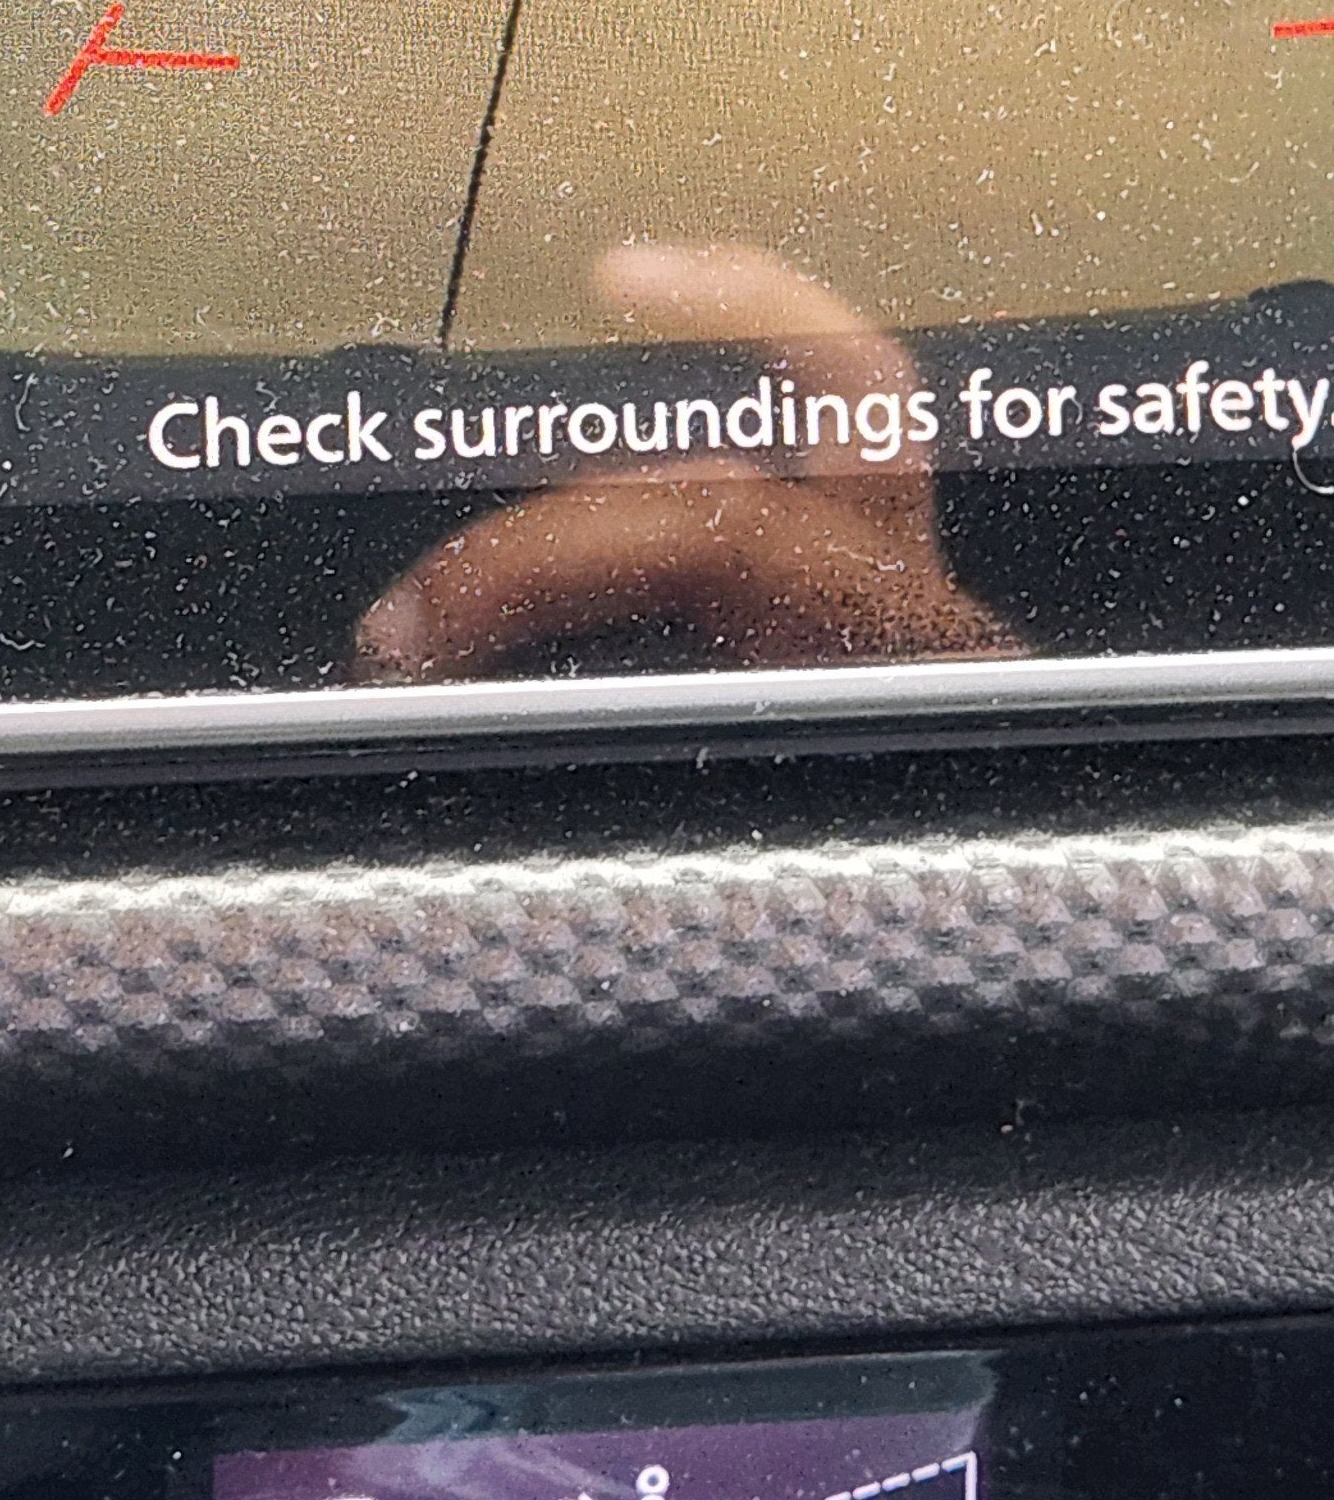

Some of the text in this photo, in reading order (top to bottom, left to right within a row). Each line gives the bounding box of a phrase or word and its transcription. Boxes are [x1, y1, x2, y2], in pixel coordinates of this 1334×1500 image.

[147, 389, 393, 473] Check
[413, 376, 939, 463] surroundings
[958, 367, 1071, 439] for
